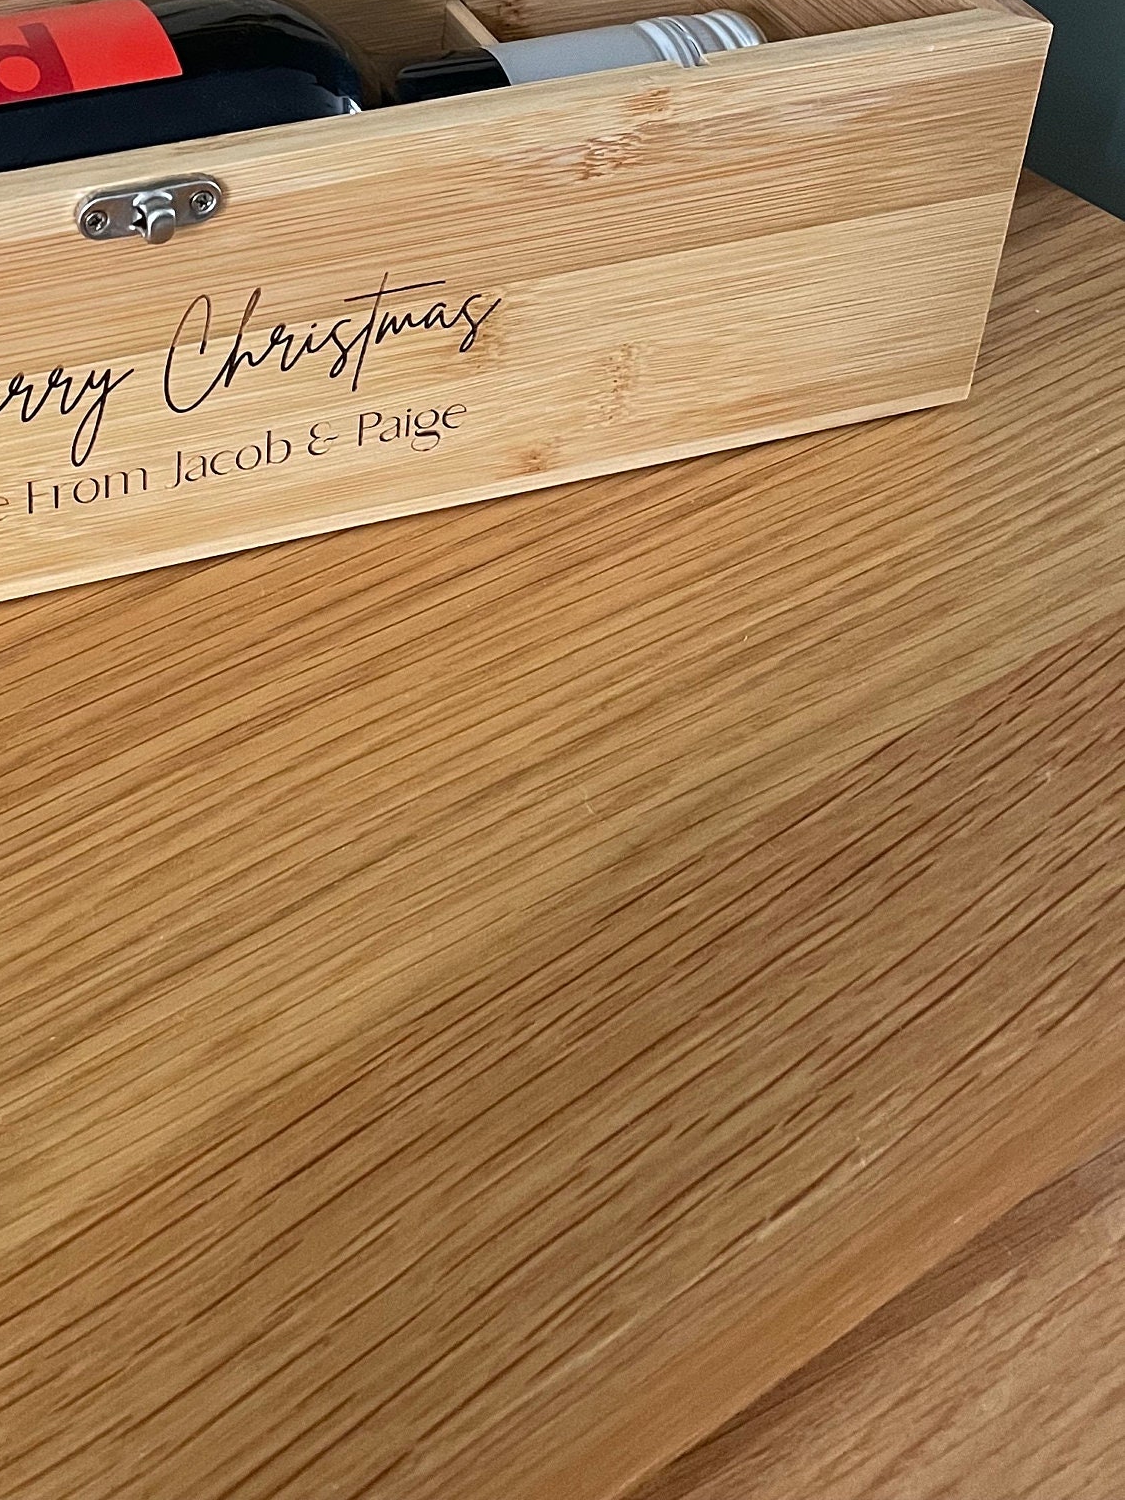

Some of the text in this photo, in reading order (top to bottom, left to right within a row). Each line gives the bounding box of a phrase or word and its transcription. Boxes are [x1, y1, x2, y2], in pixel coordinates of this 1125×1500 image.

[163, 271, 503, 414] Christmas
[26, 466, 149, 516] From
[166, 431, 291, 490] Jacob
[307, 422, 339, 456] &
[357, 402, 468, 452] Paige
